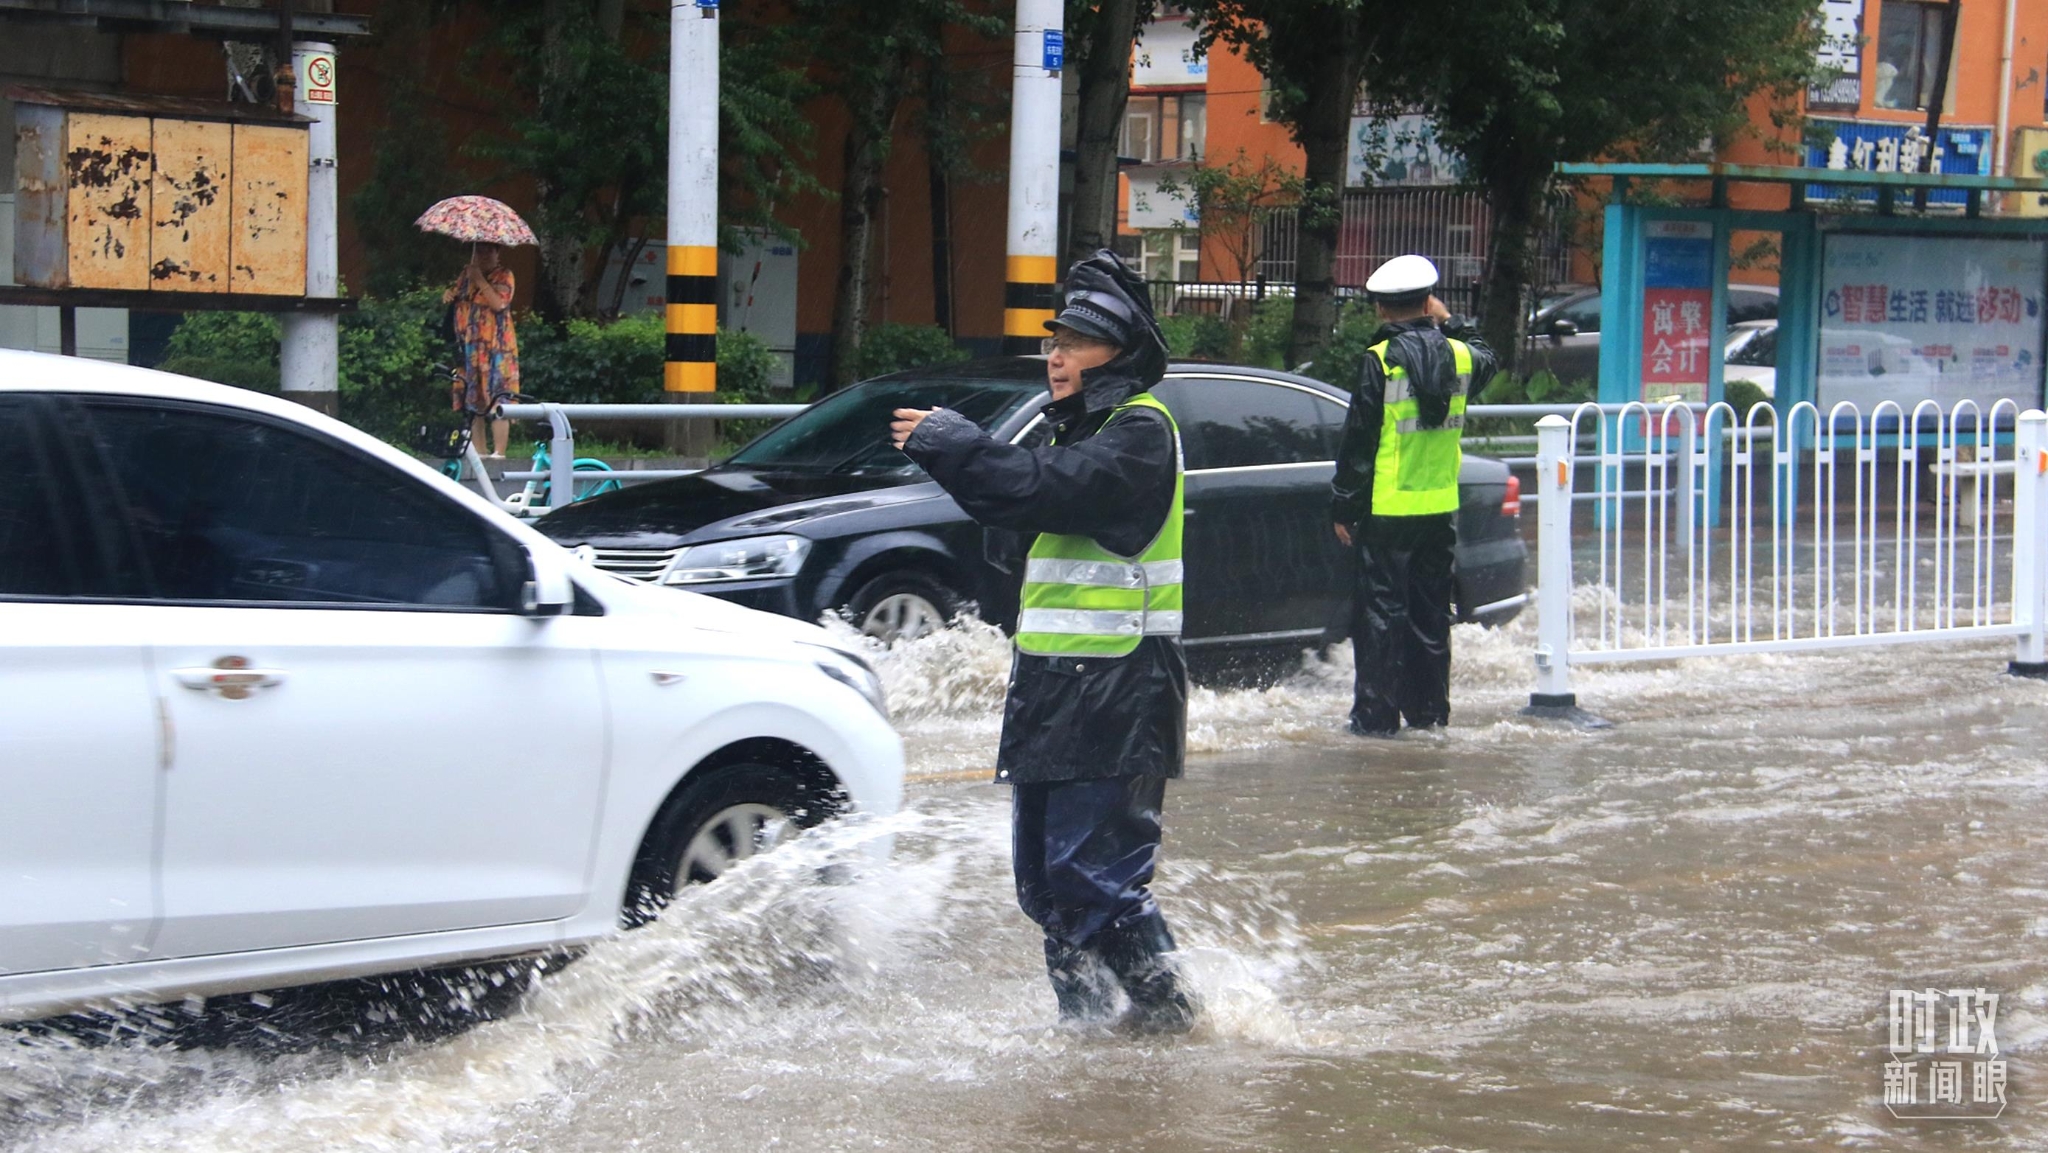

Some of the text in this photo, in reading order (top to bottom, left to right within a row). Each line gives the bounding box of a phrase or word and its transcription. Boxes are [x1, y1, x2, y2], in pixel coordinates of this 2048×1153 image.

[1652, 299, 1702, 335] 寓擎
[1842, 284, 2021, 324] 智慧生活 就选移动
[1651, 338, 1700, 374] 会计
